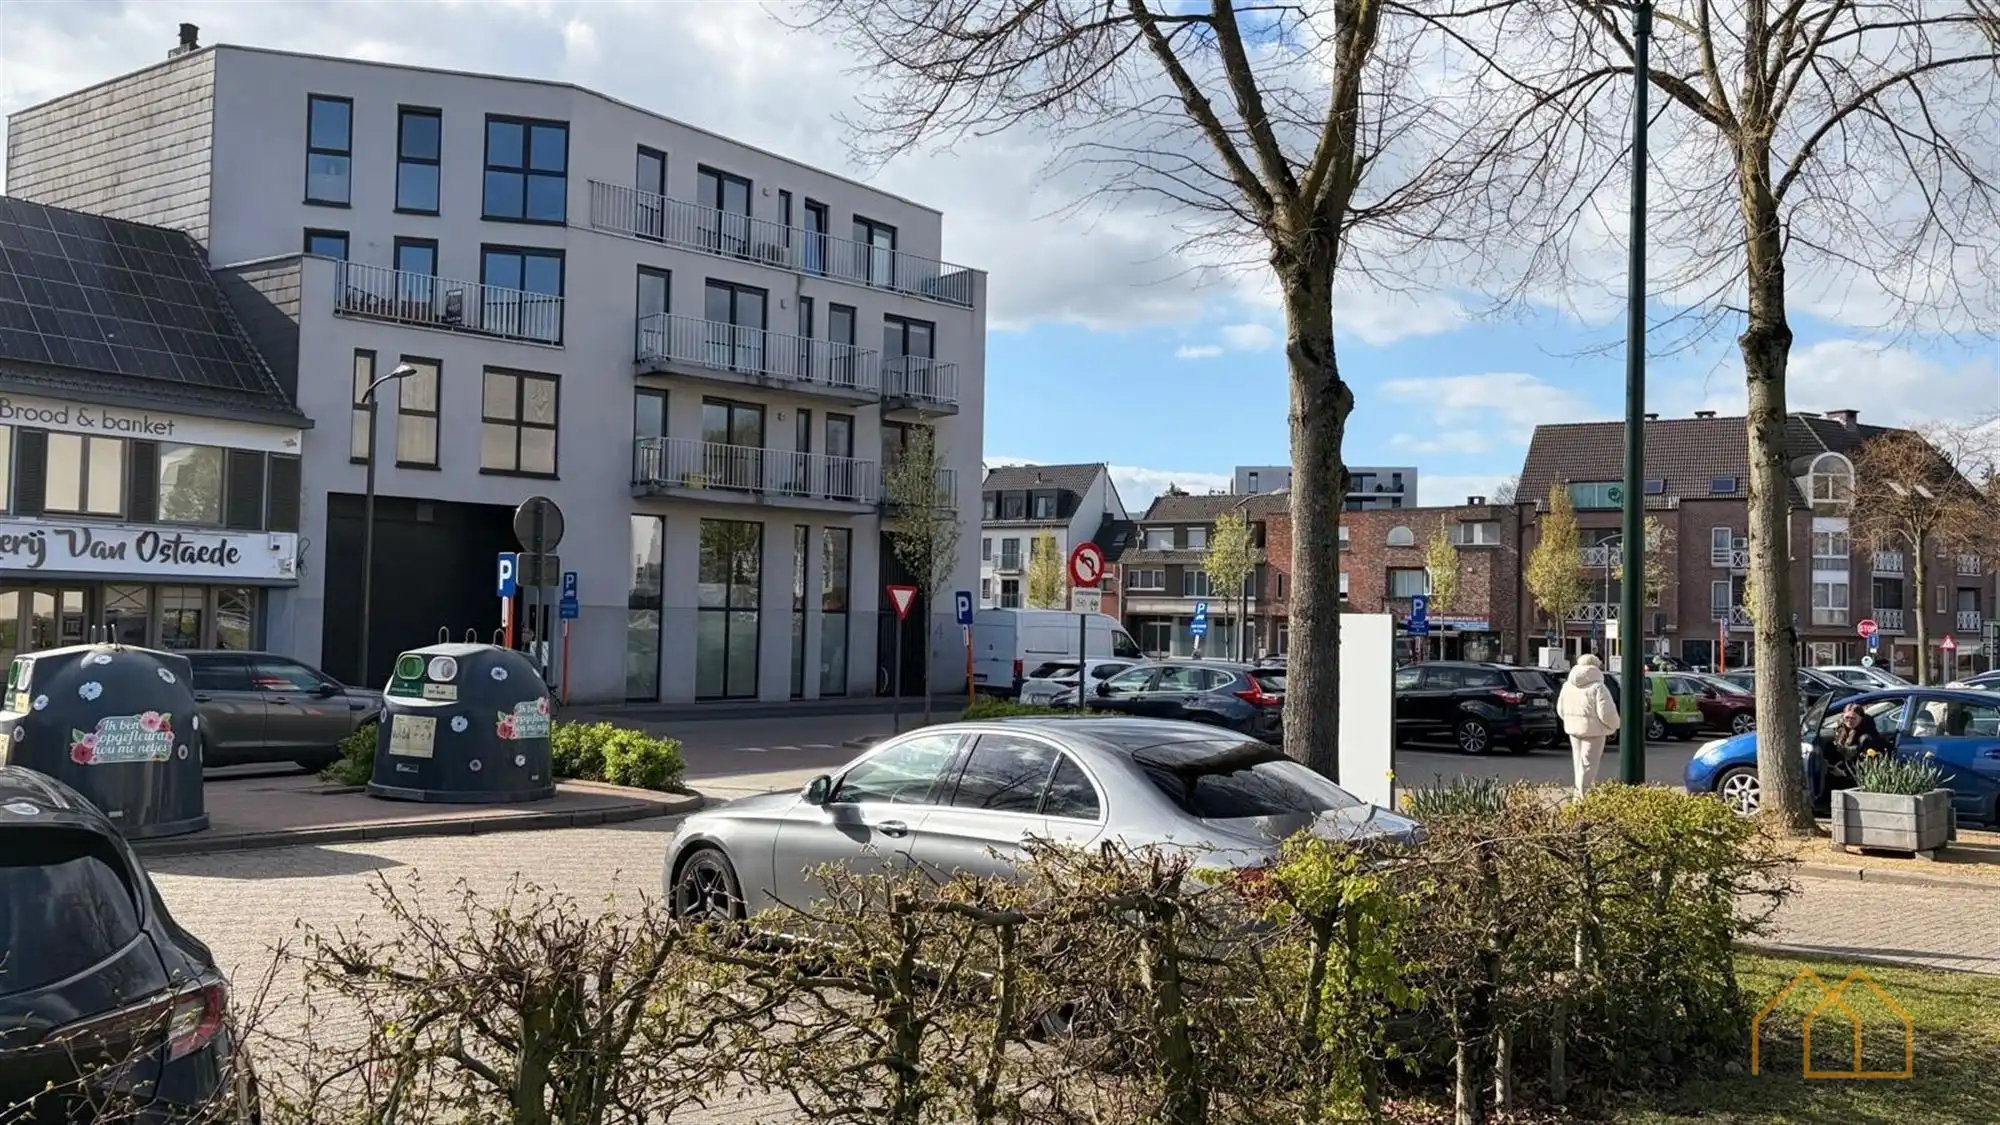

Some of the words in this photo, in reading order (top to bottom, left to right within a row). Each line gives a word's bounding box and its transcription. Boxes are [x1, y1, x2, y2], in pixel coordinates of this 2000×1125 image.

[0, 398, 69, 424] Brood
[76, 407, 94, 427] &
[103, 410, 175, 436] banket
[53, 527, 127, 560] Van
[136, 531, 241, 567] Ostaede
[500, 560, 512, 590] P
[566, 575, 575, 588] P
[957, 597, 969, 619] P
[1197, 603, 1206, 614] P
[1413, 599, 1424, 616] P
[1859, 624, 1876, 633] STOP
[103, 719, 117, 731] Ik
[120, 720, 140, 731] ben
[118, 746, 134, 754] me
